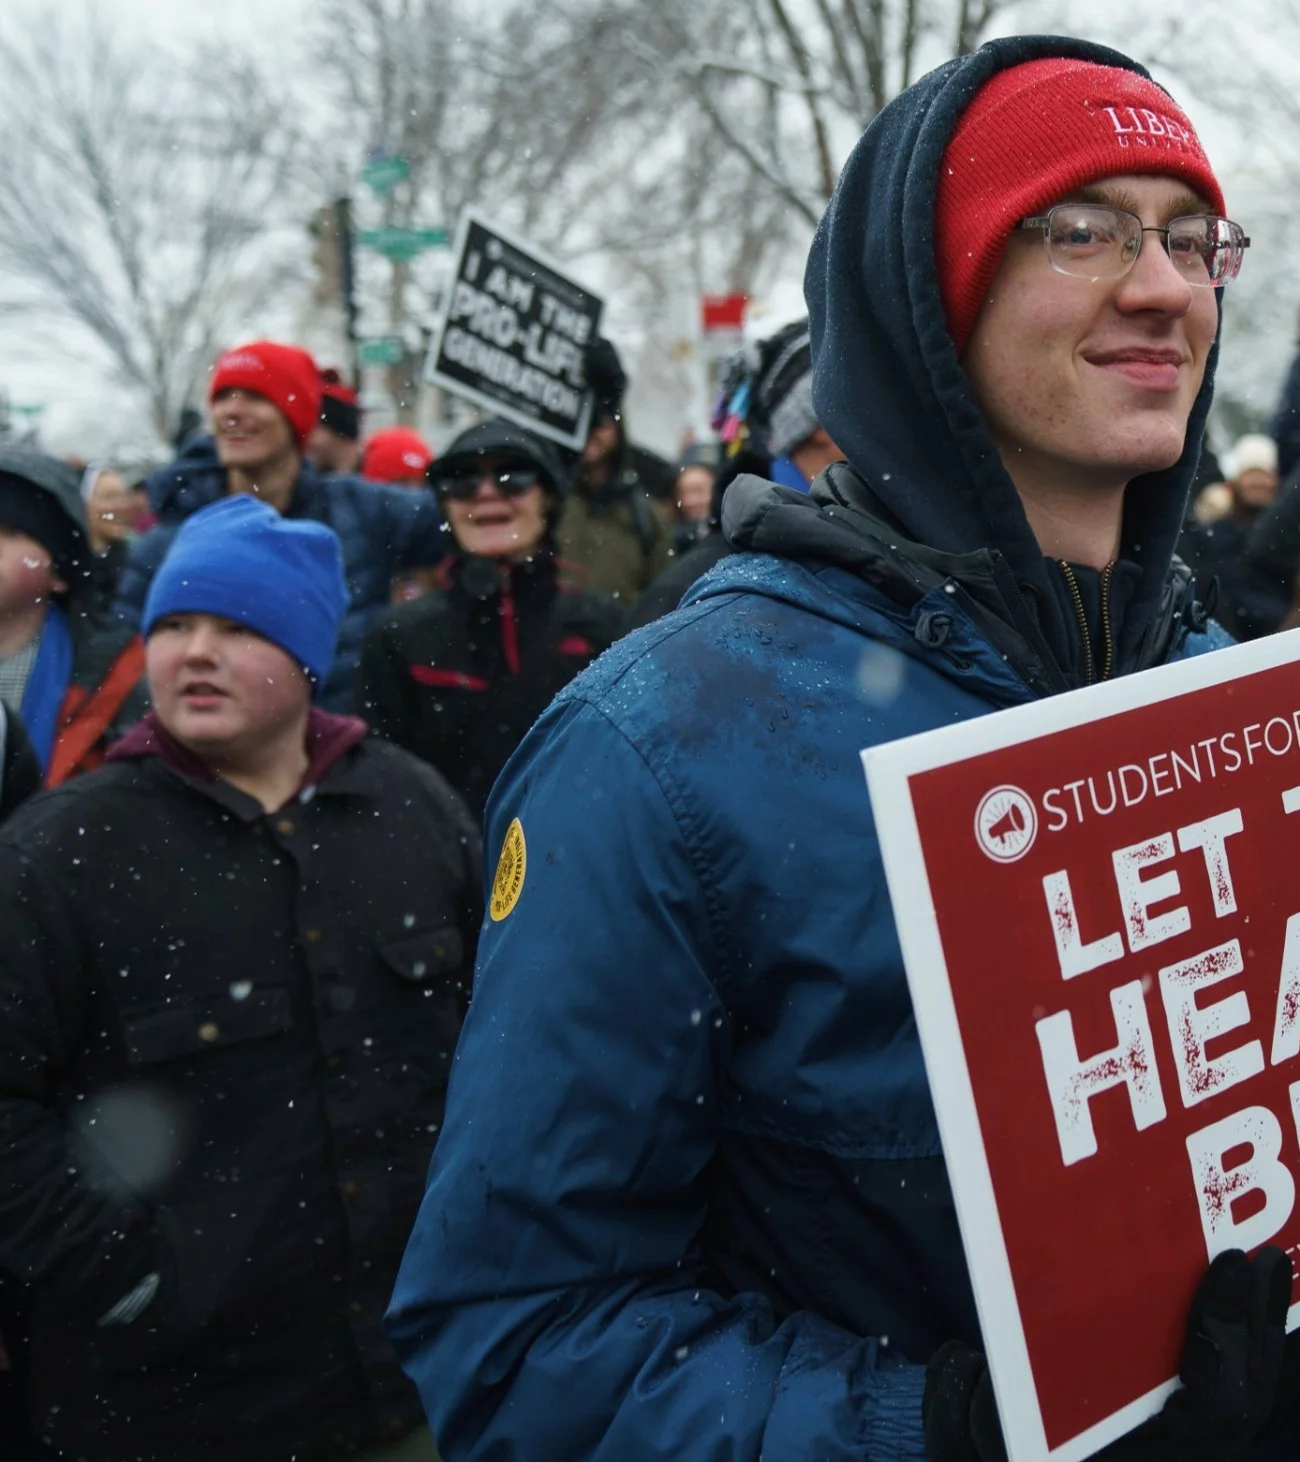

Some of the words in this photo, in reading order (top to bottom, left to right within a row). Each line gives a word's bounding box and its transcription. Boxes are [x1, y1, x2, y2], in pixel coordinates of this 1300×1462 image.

[464, 251, 481, 281] I
[485, 265, 535, 313] AM
[539, 293, 592, 344] THE
[443, 326, 581, 420] GENERATION
[1042, 808, 1244, 981] LET
